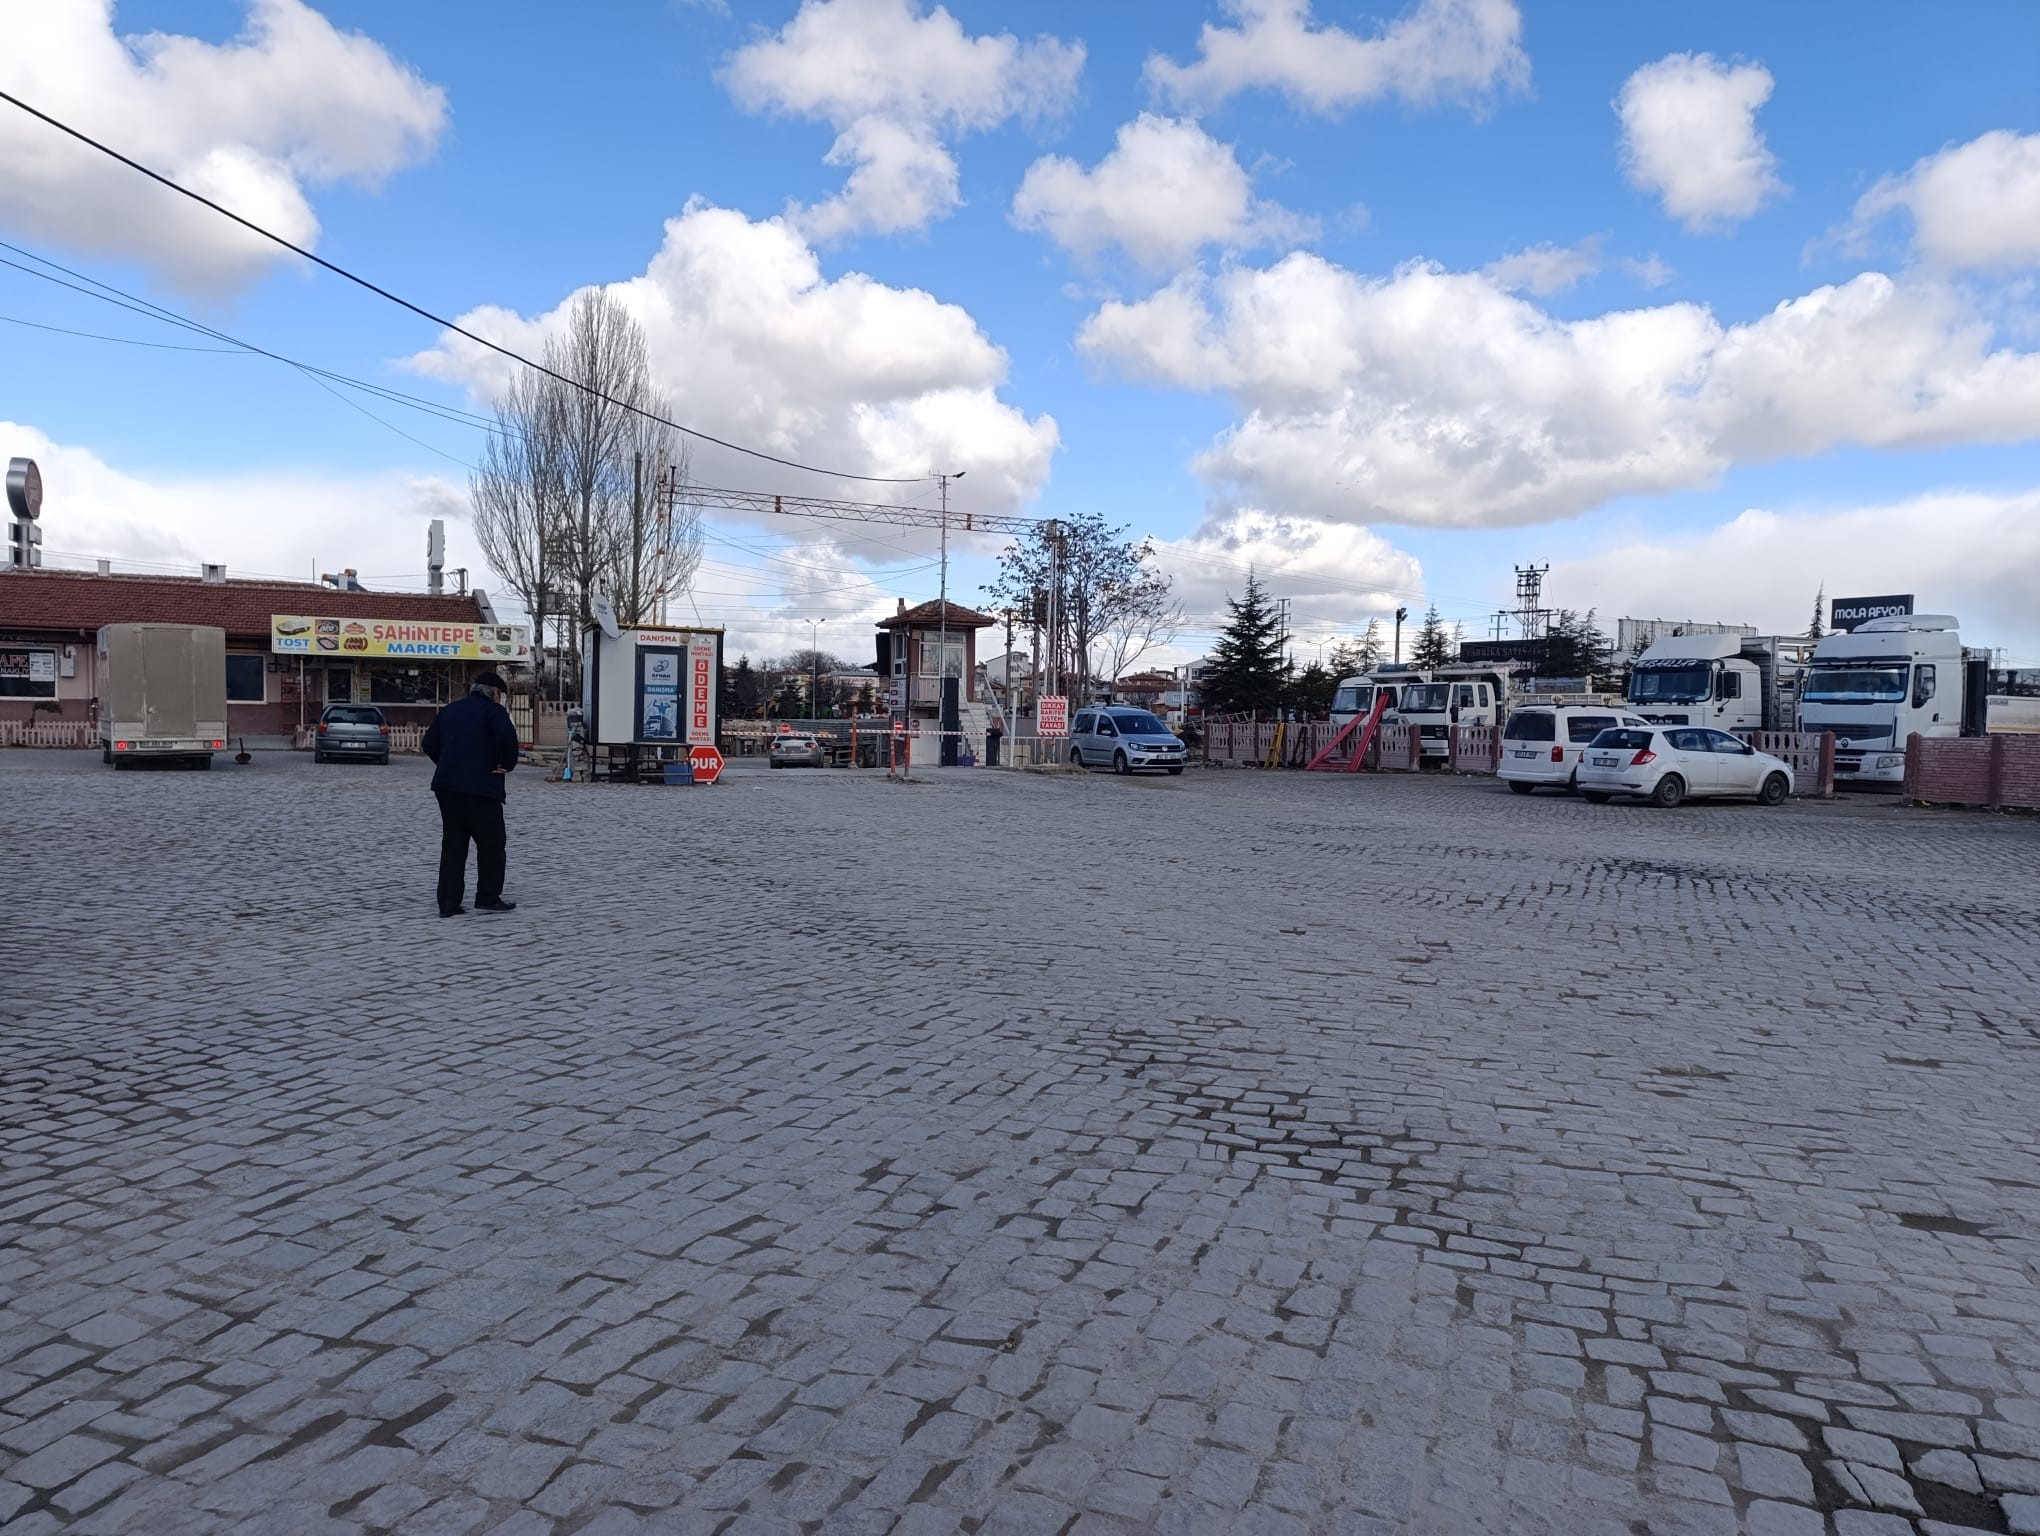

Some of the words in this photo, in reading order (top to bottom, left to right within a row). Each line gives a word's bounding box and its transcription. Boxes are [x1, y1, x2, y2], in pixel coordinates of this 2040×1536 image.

[1834, 608, 1866, 619] MOLA
[1868, 605, 1905, 617] AFYON
[275, 638, 310, 647] TOST
[387, 643, 461, 656] MARKET
[690, 757, 718, 769] DUR
